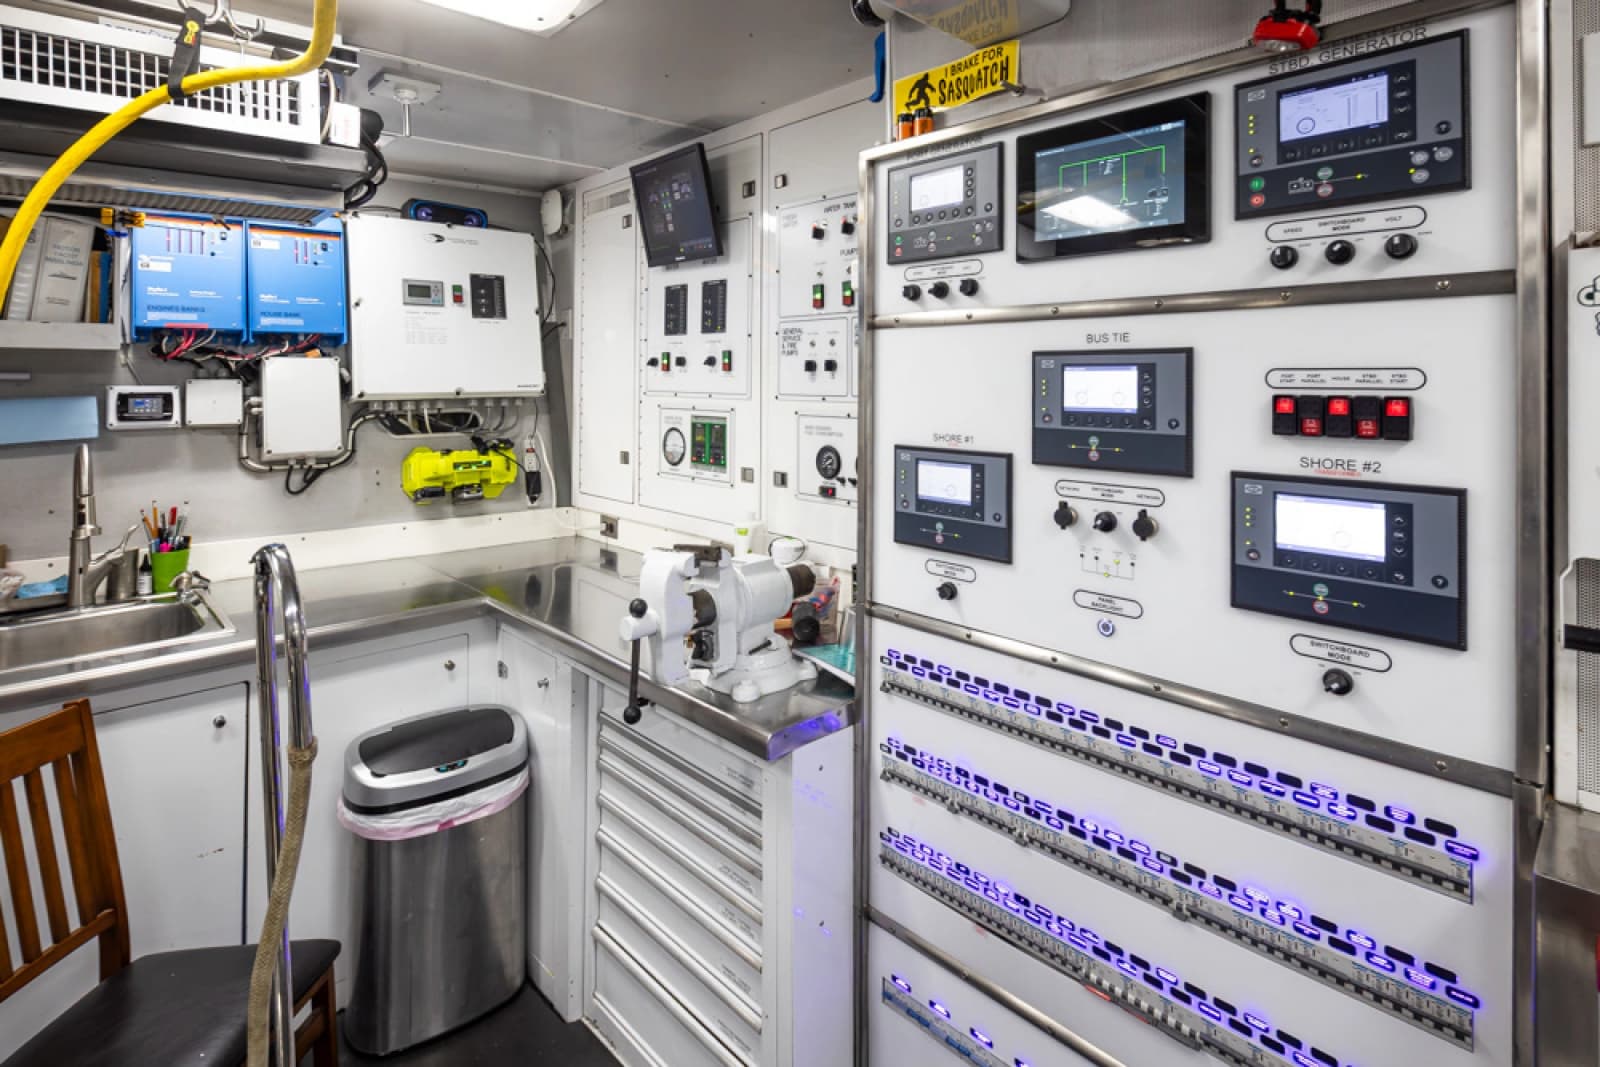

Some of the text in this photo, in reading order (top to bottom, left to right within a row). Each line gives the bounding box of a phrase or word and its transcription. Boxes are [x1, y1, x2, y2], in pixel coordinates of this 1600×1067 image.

[1268, 27, 1428, 75] STBD. GENERATOR
[944, 47, 1004, 78] I BRAKE FOR
[938, 56, 1009, 105] SASQUATCH
[1086, 332, 1131, 344] BUS TIE
[932, 433, 963, 444] SHORE
[964, 435, 975, 444] #1
[1300, 456, 1383, 474] SHORE #2
[1310, 639, 1371, 658] SWITCHBOARD
[1327, 651, 1351, 662] MODE
